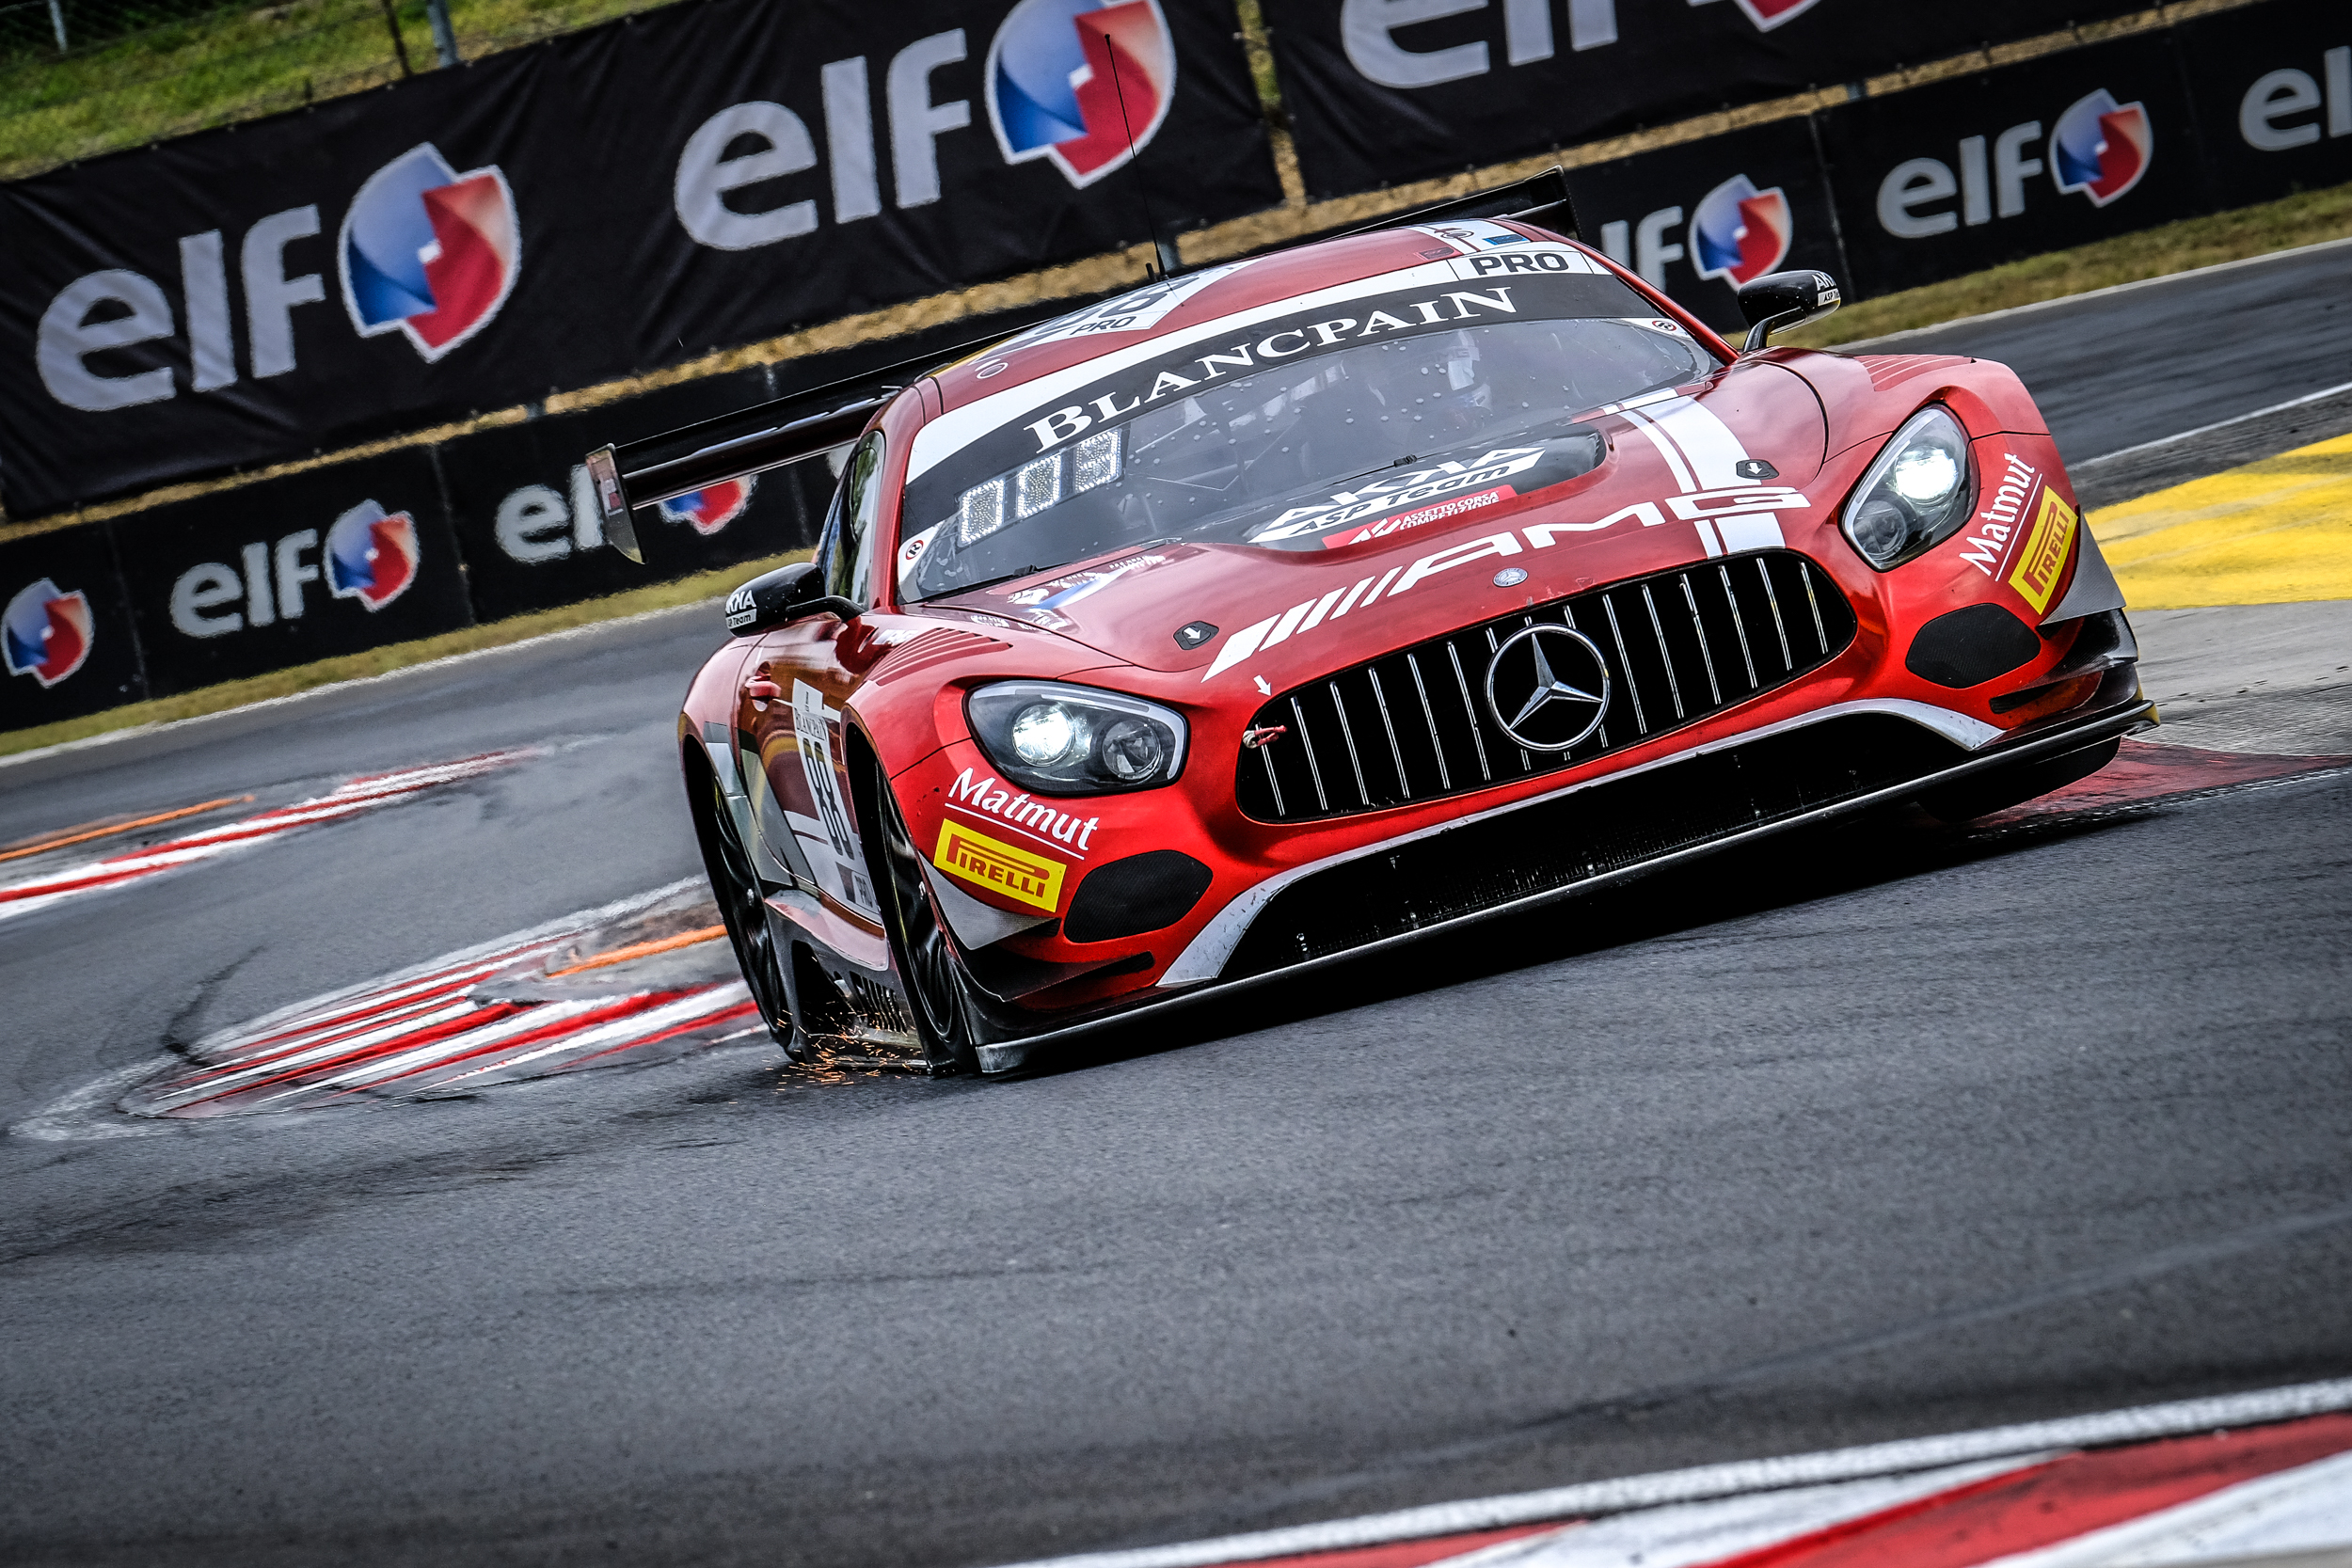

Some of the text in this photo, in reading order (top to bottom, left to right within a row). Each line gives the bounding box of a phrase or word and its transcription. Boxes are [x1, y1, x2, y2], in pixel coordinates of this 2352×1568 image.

[674, 27, 970, 251] elf
[2239, 45, 2352, 151] el
[1877, 119, 2043, 240] elf
[36, 204, 326, 412] elf
[1470, 253, 1569, 276] PRO
[1024, 286, 1516, 453] BLANCPAIN
[1070, 316, 1136, 336] PRO
[495, 464, 604, 564] el
[1290, 467, 1510, 536] ASP Team
[1402, 491, 1500, 524] ASSETTO CORSA
[1959, 452, 2035, 577] Matmut
[2023, 500, 2070, 597] PIRELLI
[169, 528, 319, 639] elf
[803, 737, 855, 861] 88
[947, 767, 1100, 851] Matmut
[946, 832, 1051, 898] PIRELLI
